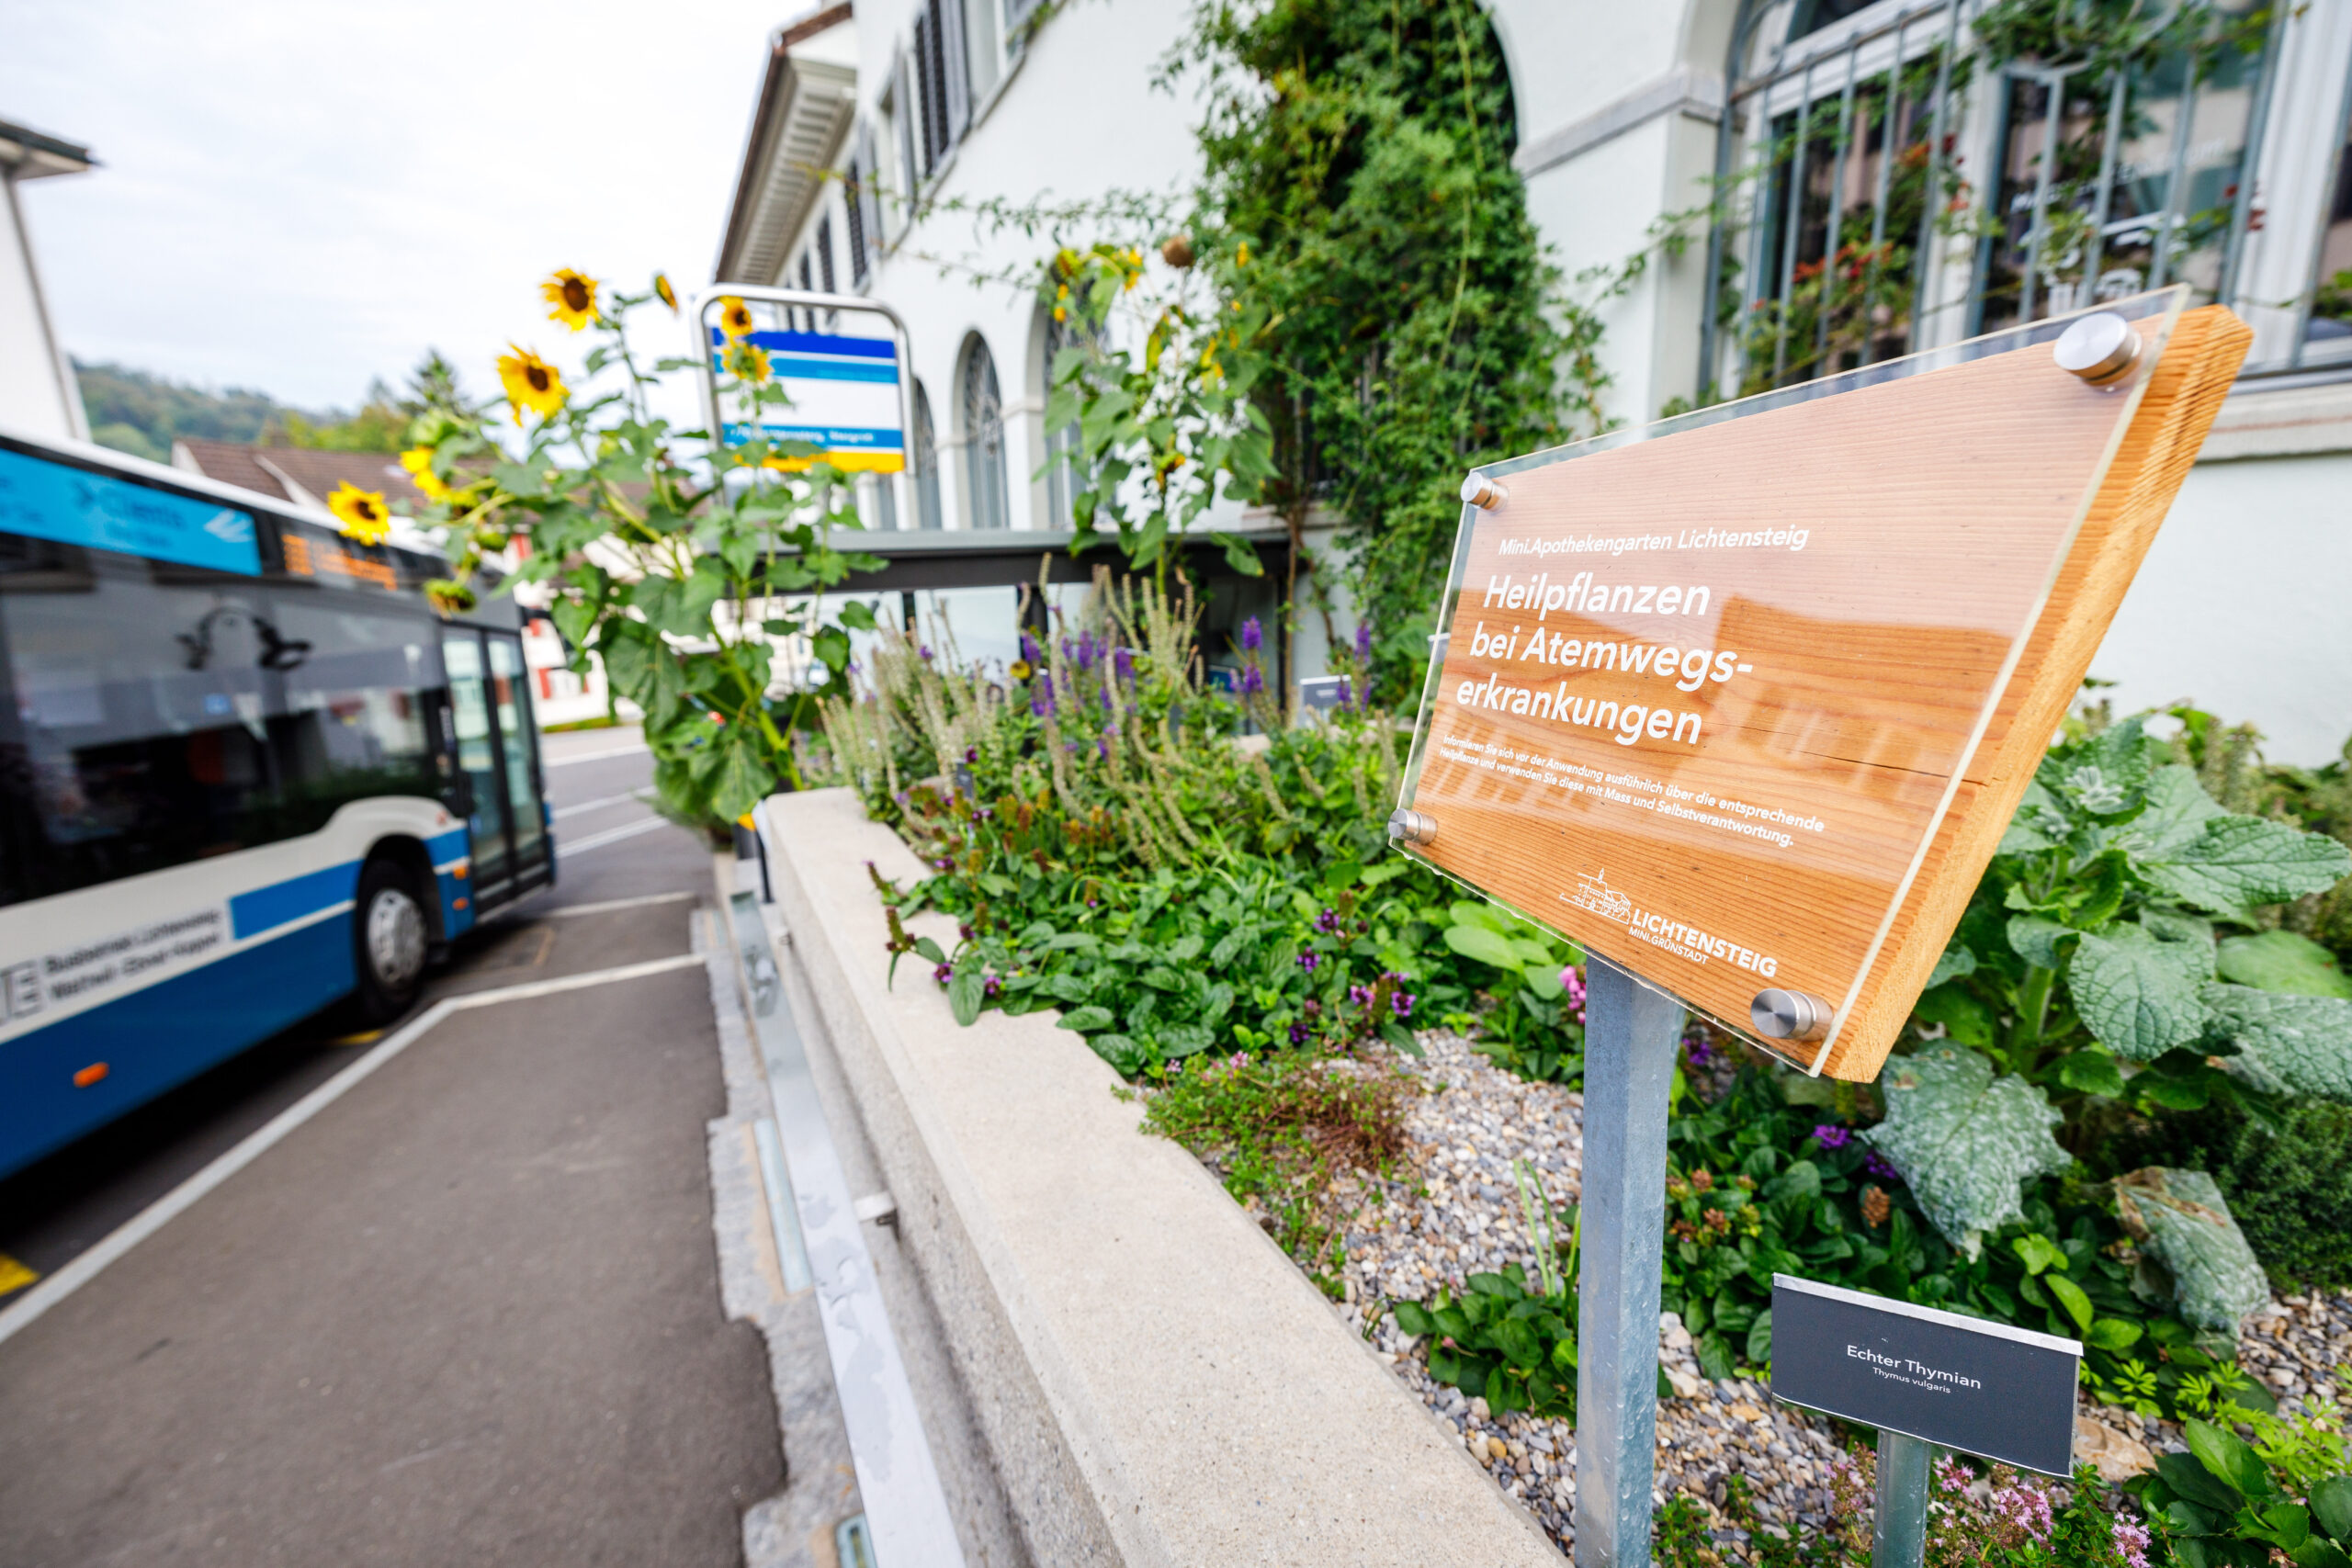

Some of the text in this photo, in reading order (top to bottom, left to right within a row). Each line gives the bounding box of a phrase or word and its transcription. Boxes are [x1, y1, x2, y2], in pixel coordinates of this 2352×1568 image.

[1498, 524, 1810, 558] Mini.Apothekengarten Lichtensteig
[1483, 571, 1711, 621] Heilpflanzen
[1469, 621, 1753, 692] bei Atemwegs-
[1456, 671, 1702, 746] erkrankungen
[1439, 747, 1794, 848] Heilpflanze und verwenden Sie diese mit Mass und Selbstverantwortung.
[1442, 735, 1825, 831] Informieren Sie sich vor der Anwendung ausführlich über die entsprechende
[1628, 926, 1709, 964] MINI.GRÜNSTADT
[1632, 908, 1778, 977] LICHTENSTEIG
[1847, 1345, 1981, 1389] Echter Thymian
[1872, 1367, 1951, 1393] Thymus vulgaris
